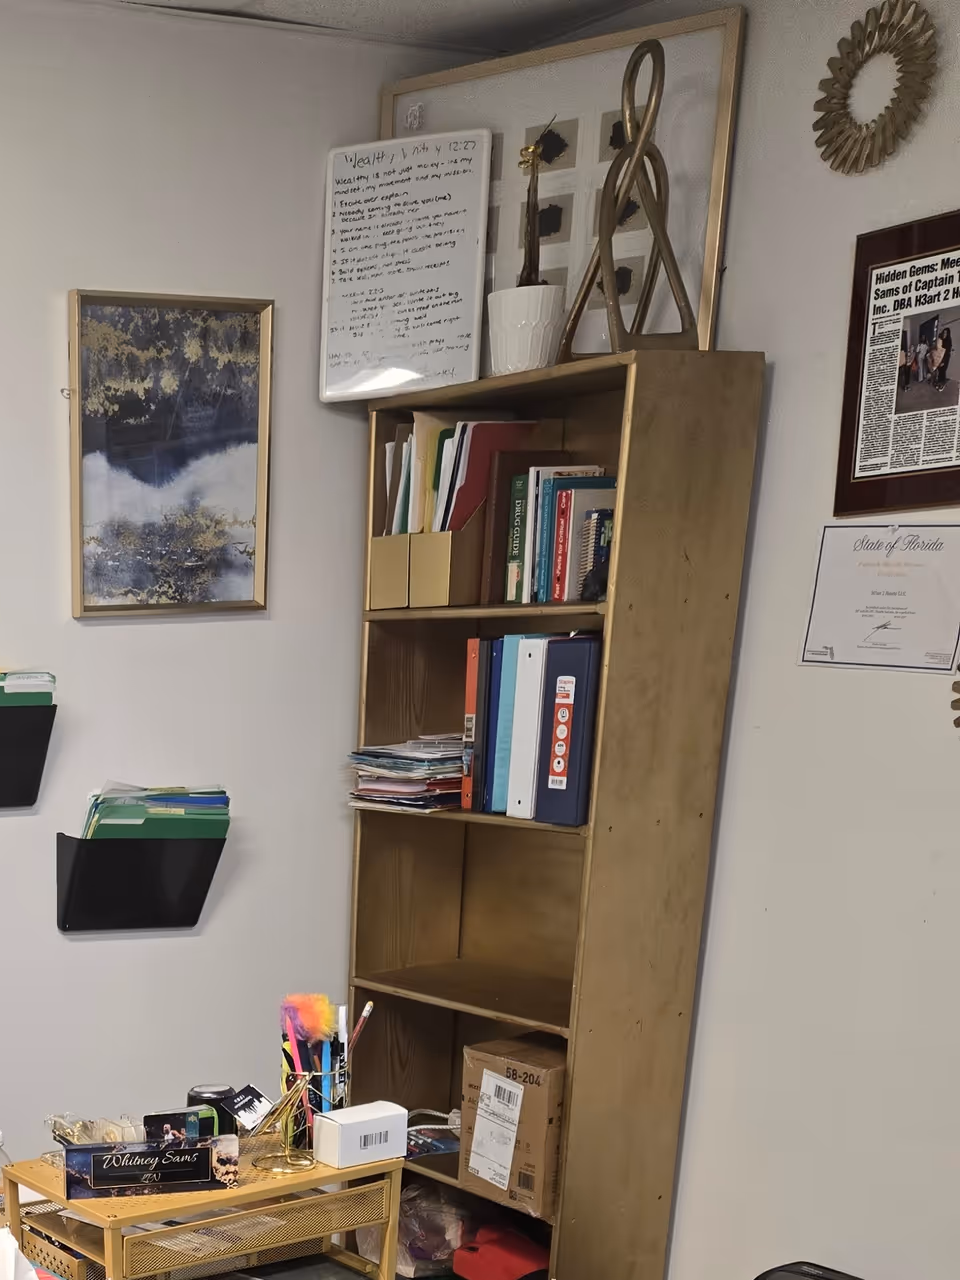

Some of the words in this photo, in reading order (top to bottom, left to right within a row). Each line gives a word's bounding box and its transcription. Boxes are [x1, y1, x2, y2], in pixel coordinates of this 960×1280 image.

[875, 270, 907, 285] Hidden
[909, 263, 938, 278] Gems:
[874, 287, 900, 301] Sams
[902, 281, 913, 295] of
[914, 273, 954, 292] Captain
[872, 304, 890, 316] Inc.
[893, 297, 912, 312] DBA
[914, 292, 942, 307] H3art
[943, 289, 951, 301] 2
[514, 499, 522, 526] DRUG
[512, 527, 521, 556] GUIDE
[853, 534, 884, 552] State
[884, 536, 902, 558] of
[900, 534, 944, 552] Florida
[505, 1067, 542, 1087] 58-204
[102, 1153, 161, 1170] Whitney
[161, 1150, 199, 1164] Sams
